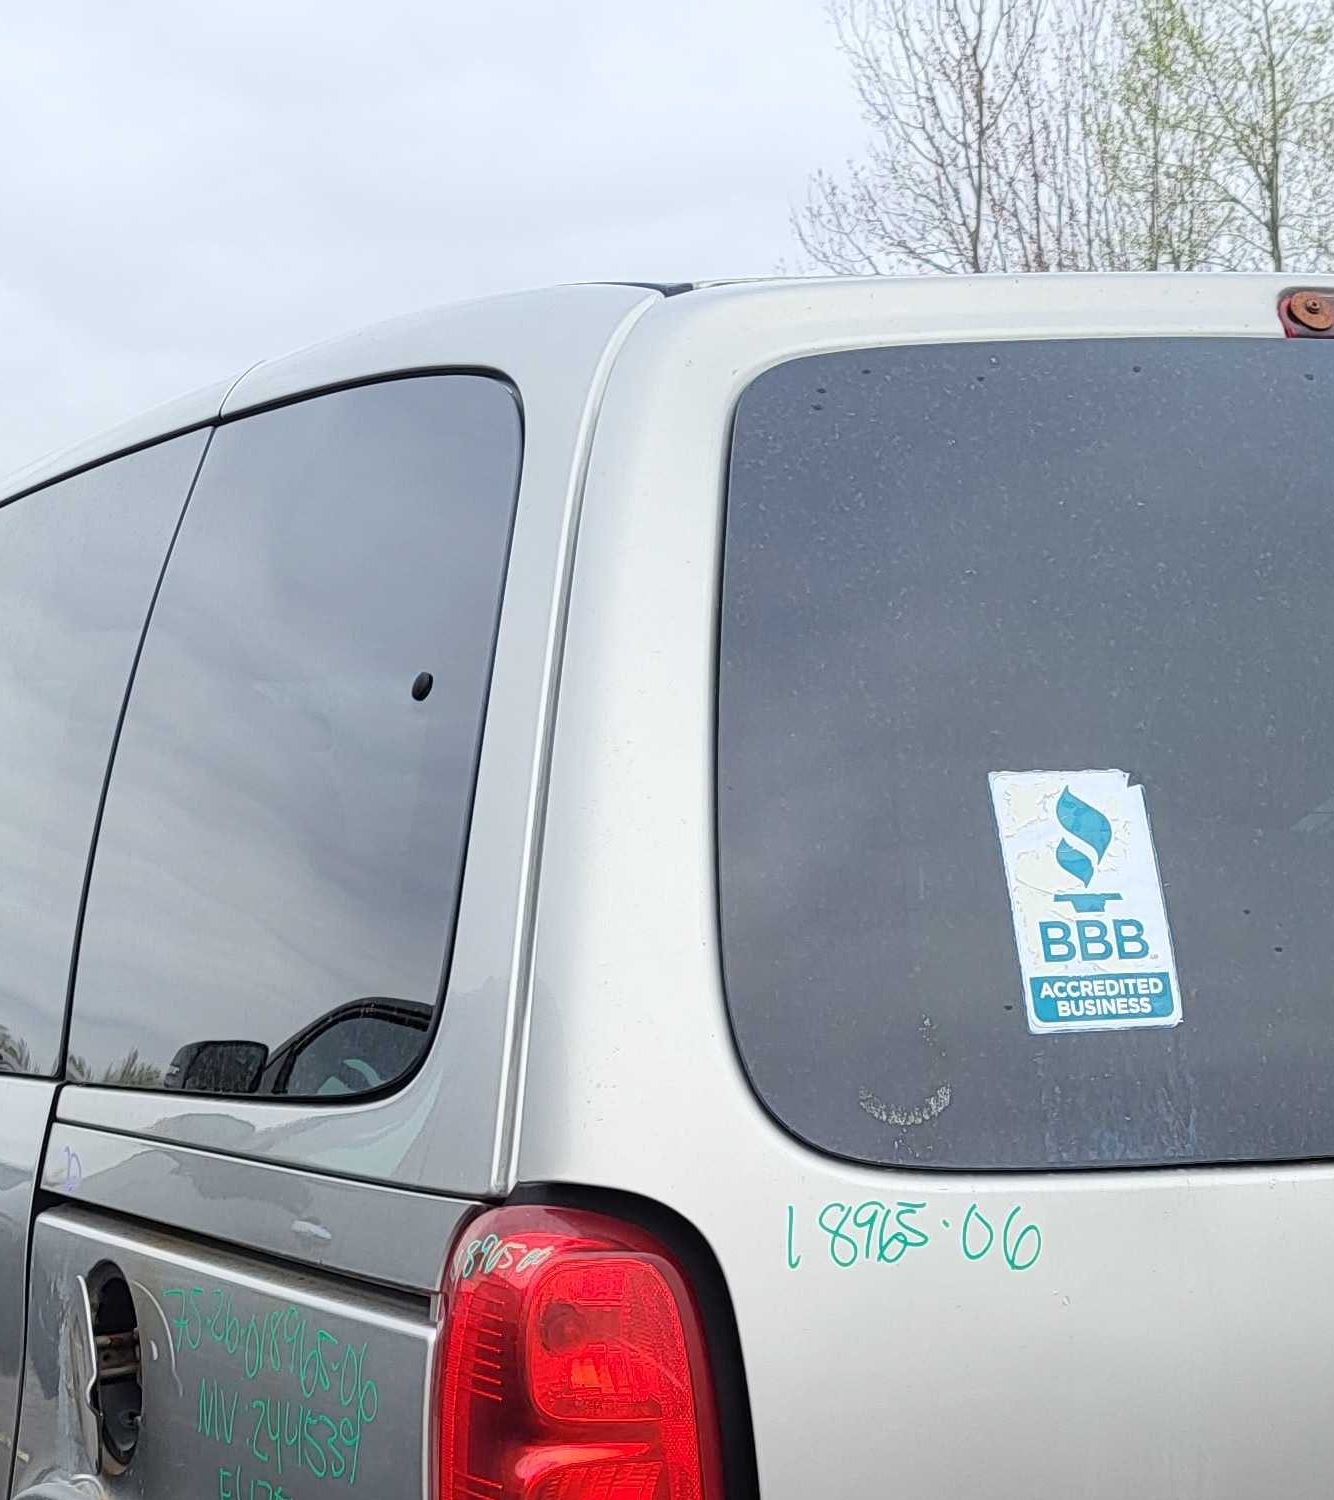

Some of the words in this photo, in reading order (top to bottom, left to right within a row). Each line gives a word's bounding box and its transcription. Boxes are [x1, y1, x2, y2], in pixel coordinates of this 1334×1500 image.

[1038, 918, 1150, 963] BBB
[1040, 978, 1163, 1000] ACCREDITED
[1056, 997, 1153, 1018] BUSINESS
